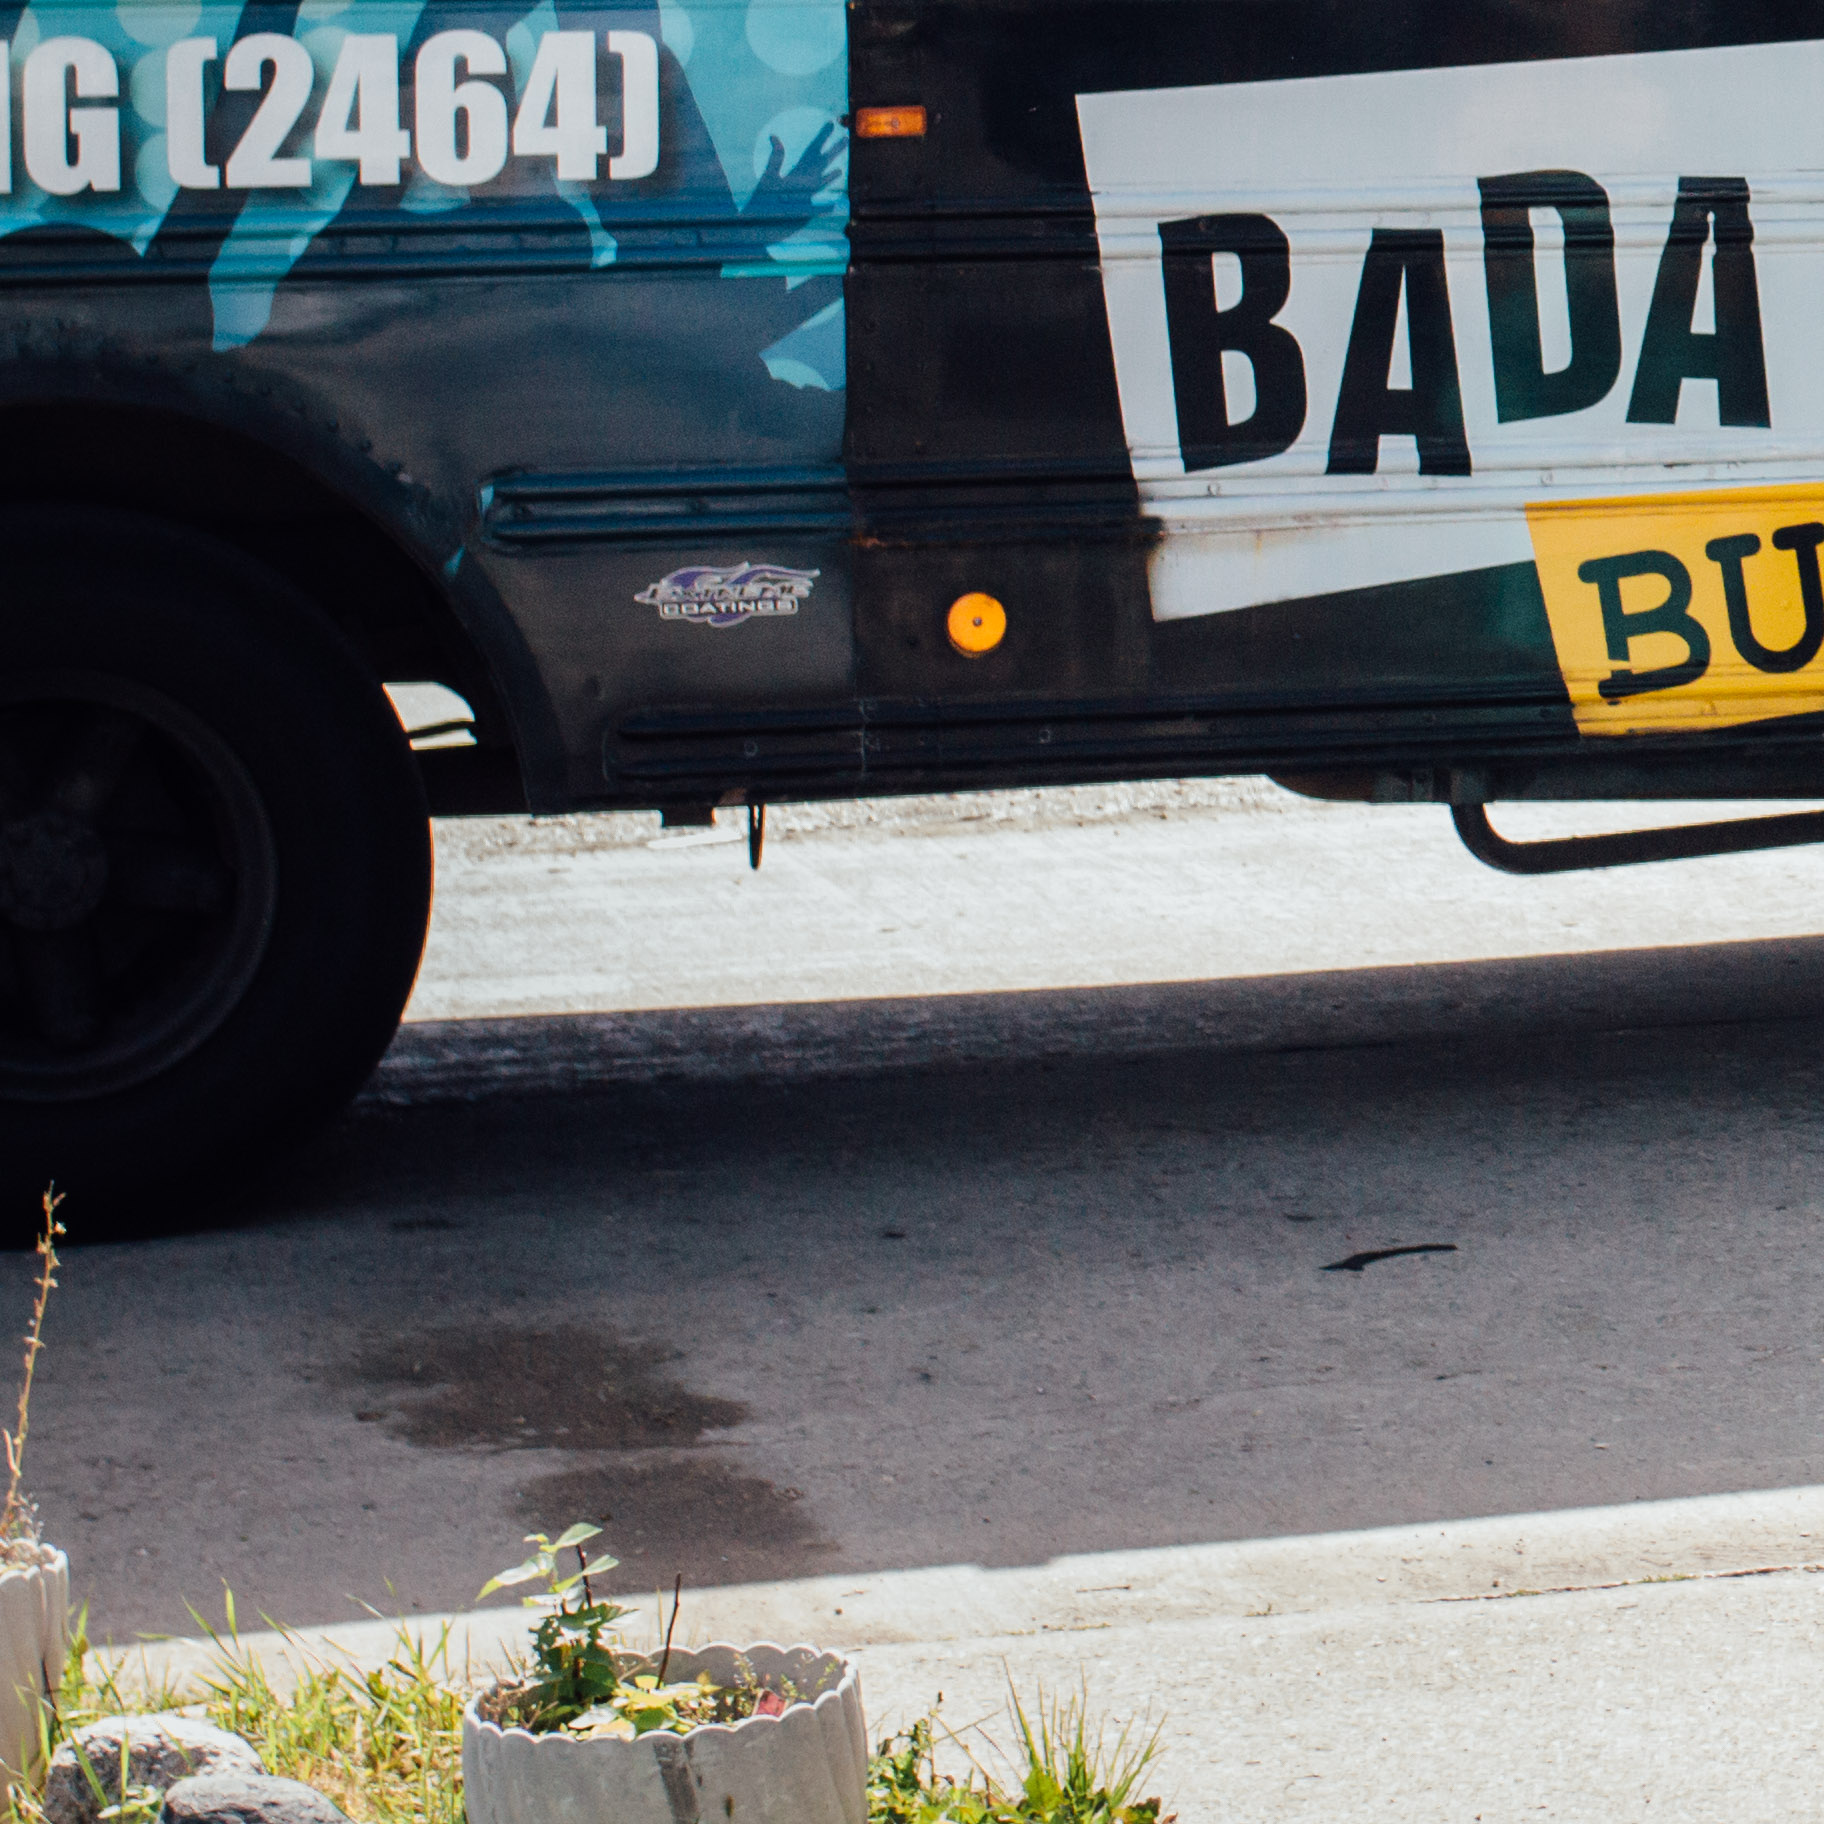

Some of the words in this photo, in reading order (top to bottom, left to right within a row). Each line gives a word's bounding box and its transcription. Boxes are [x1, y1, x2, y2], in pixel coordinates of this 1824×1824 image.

[0, 35, 121, 196] G
[166, 29, 660, 190] (2464)
[1157, 169, 1771, 478] BADA
